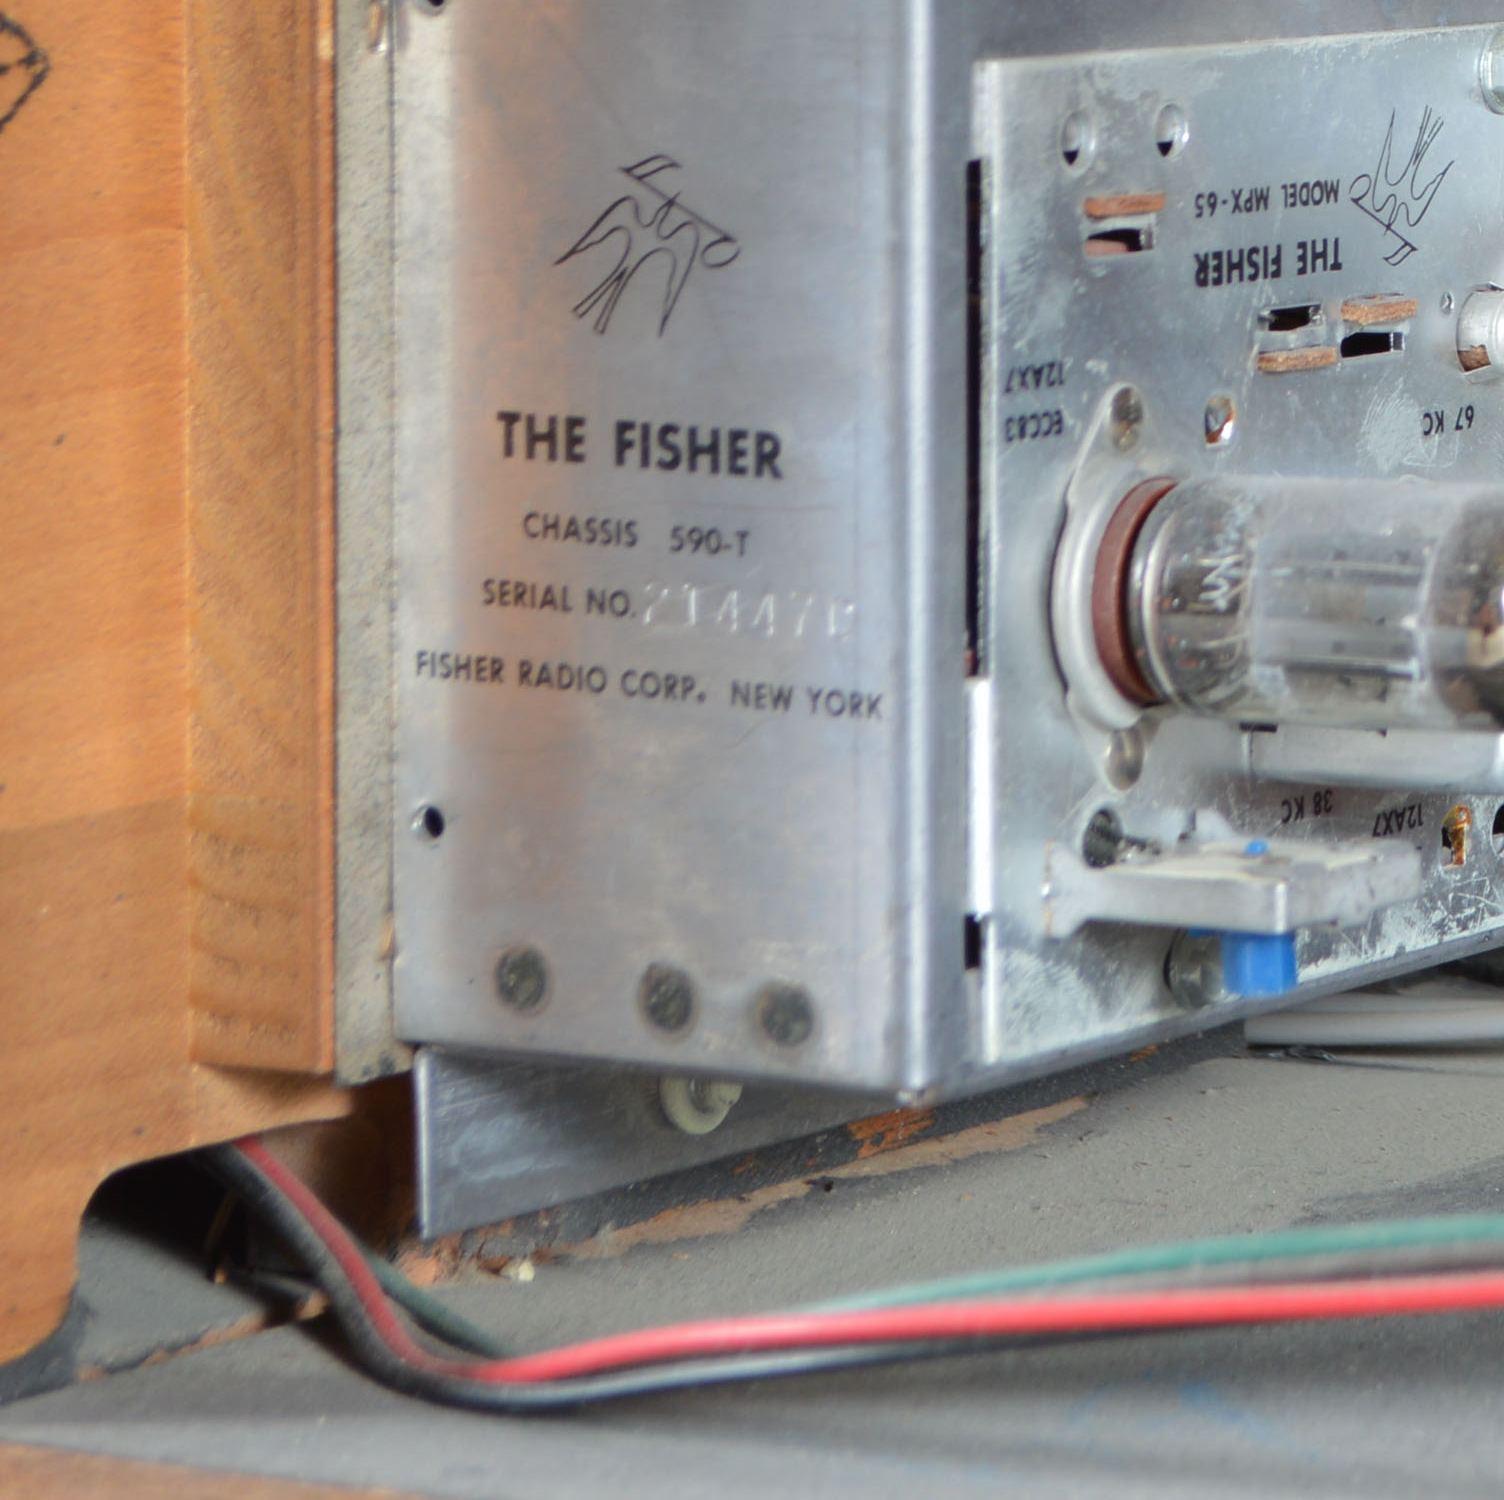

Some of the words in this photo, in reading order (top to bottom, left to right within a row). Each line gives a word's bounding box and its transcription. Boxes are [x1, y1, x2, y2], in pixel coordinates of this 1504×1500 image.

[1193, 185, 1271, 219] MPX-65
[1282, 178, 1341, 209] MODEL
[1193, 243, 1283, 288] FISHER
[1296, 237, 1343, 276] THE
[1004, 358, 1066, 394] 12AX7
[1005, 406, 1063, 443] ECC83
[1421, 410, 1445, 436] KC
[1454, 405, 1474, 432] 67
[498, 410, 587, 464] THE
[614, 420, 784, 479] FISHER
[522, 512, 639, 548] CHASSIS
[669, 525, 751, 557] 590-T
[482, 579, 572, 614] SERIAL
[585, 588, 637, 619] NO.
[415, 649, 505, 686] FISHER
[517, 661, 607, 695] RADIO
[619, 667, 707, 704] CORP.
[729, 680, 793, 712] NEW
[805, 686, 883, 720] YORK
[1279, 794, 1305, 826] KC
[1311, 788, 1334, 817] 38
[1370, 801, 1425, 838] 12AX7
